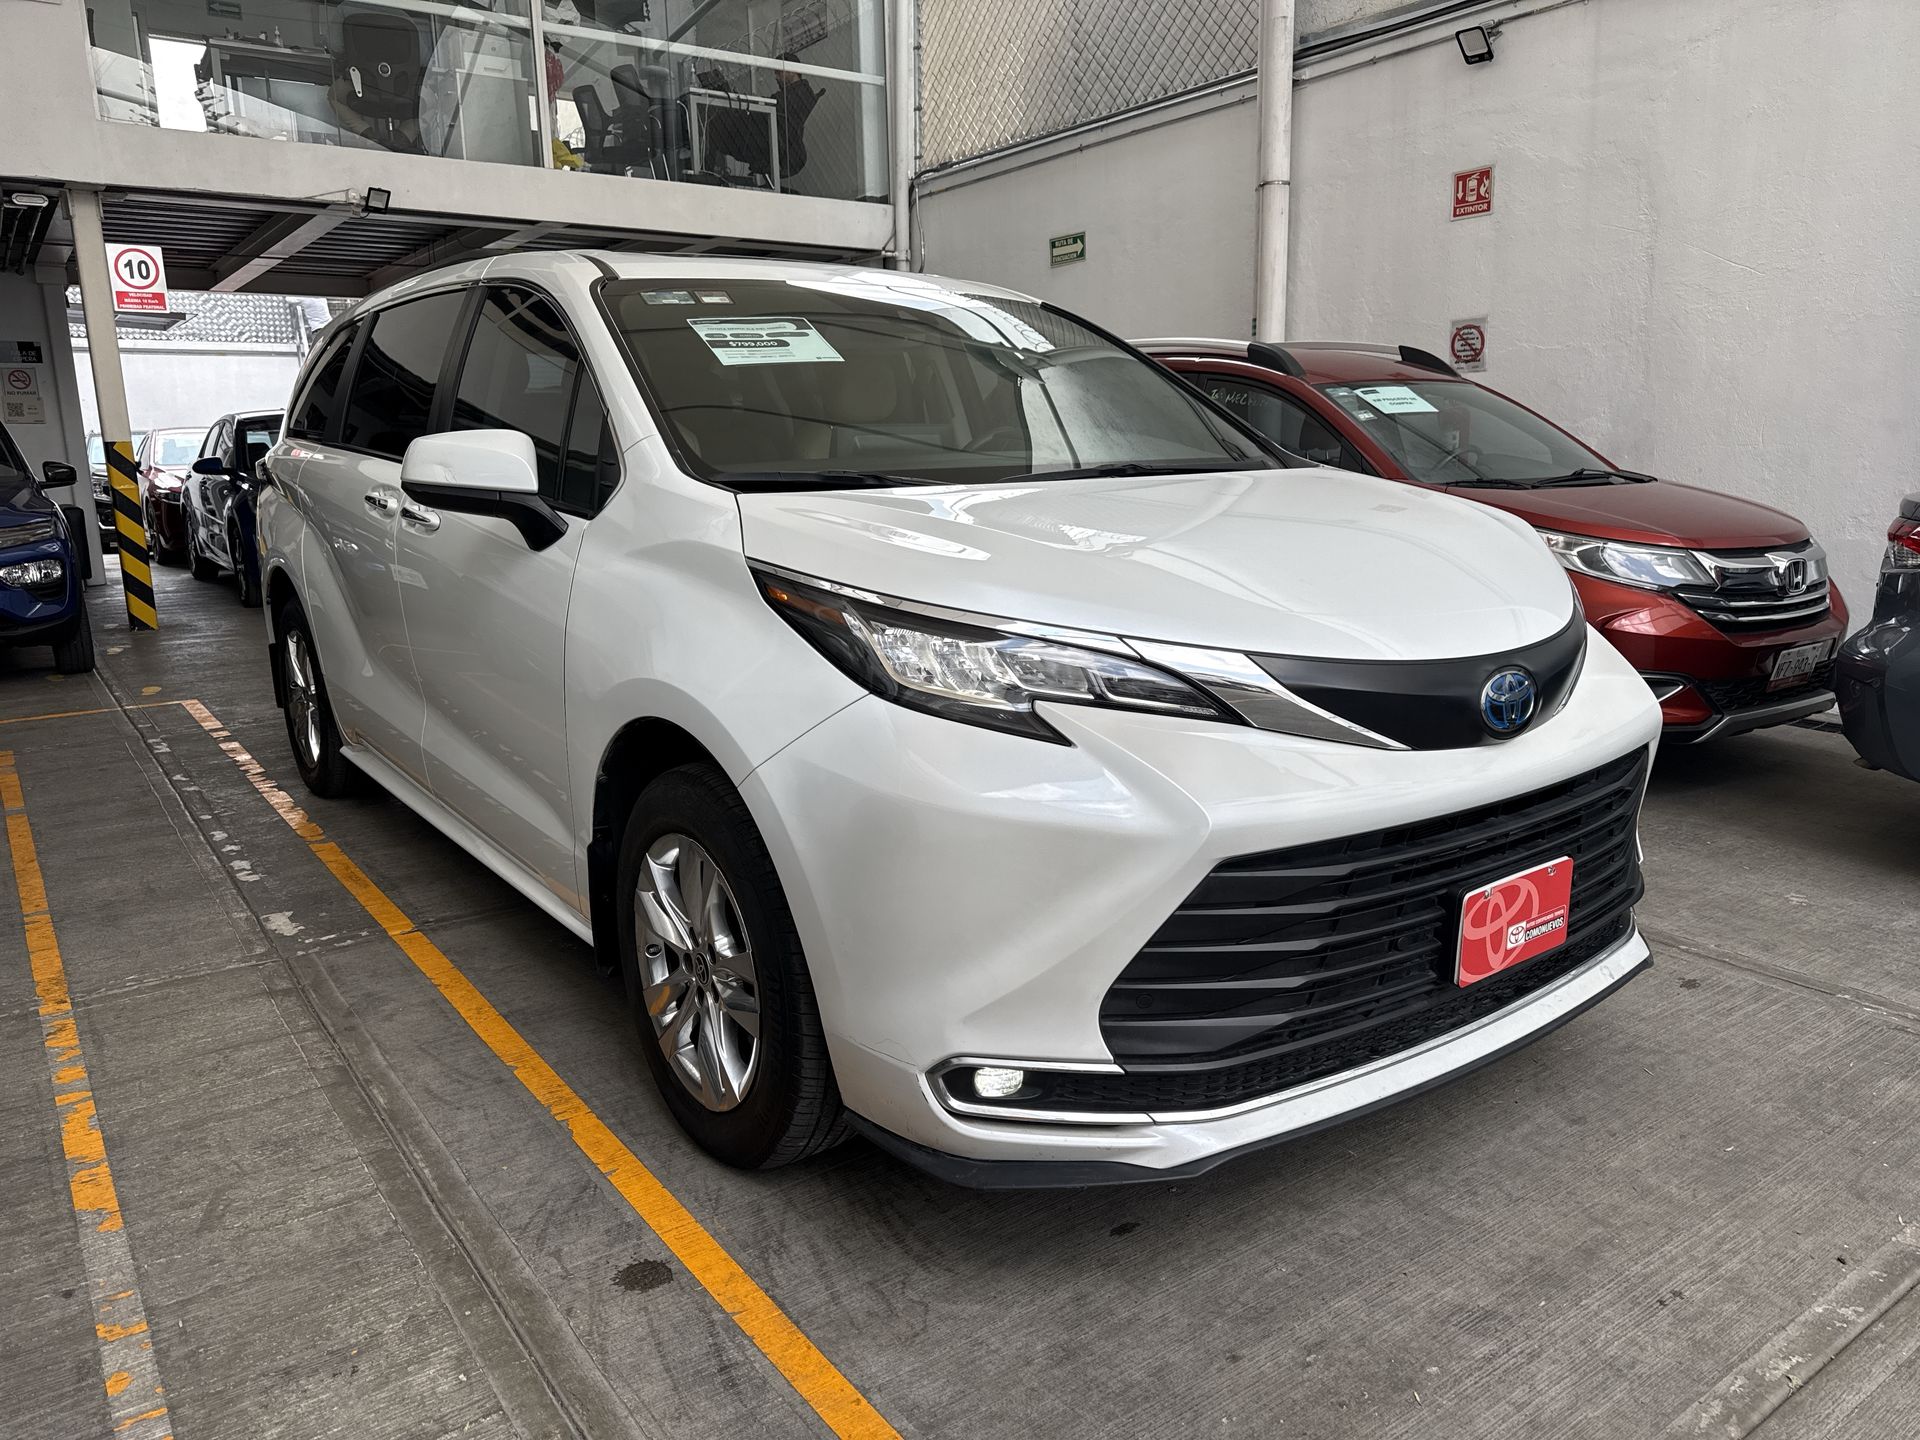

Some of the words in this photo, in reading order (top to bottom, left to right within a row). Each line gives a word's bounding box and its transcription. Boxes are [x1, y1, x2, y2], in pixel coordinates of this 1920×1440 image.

[1456, 203, 1488, 215] EXTINTOR
[124, 259, 151, 280] 10
[1525, 916, 1564, 940] COMONUEVOS
